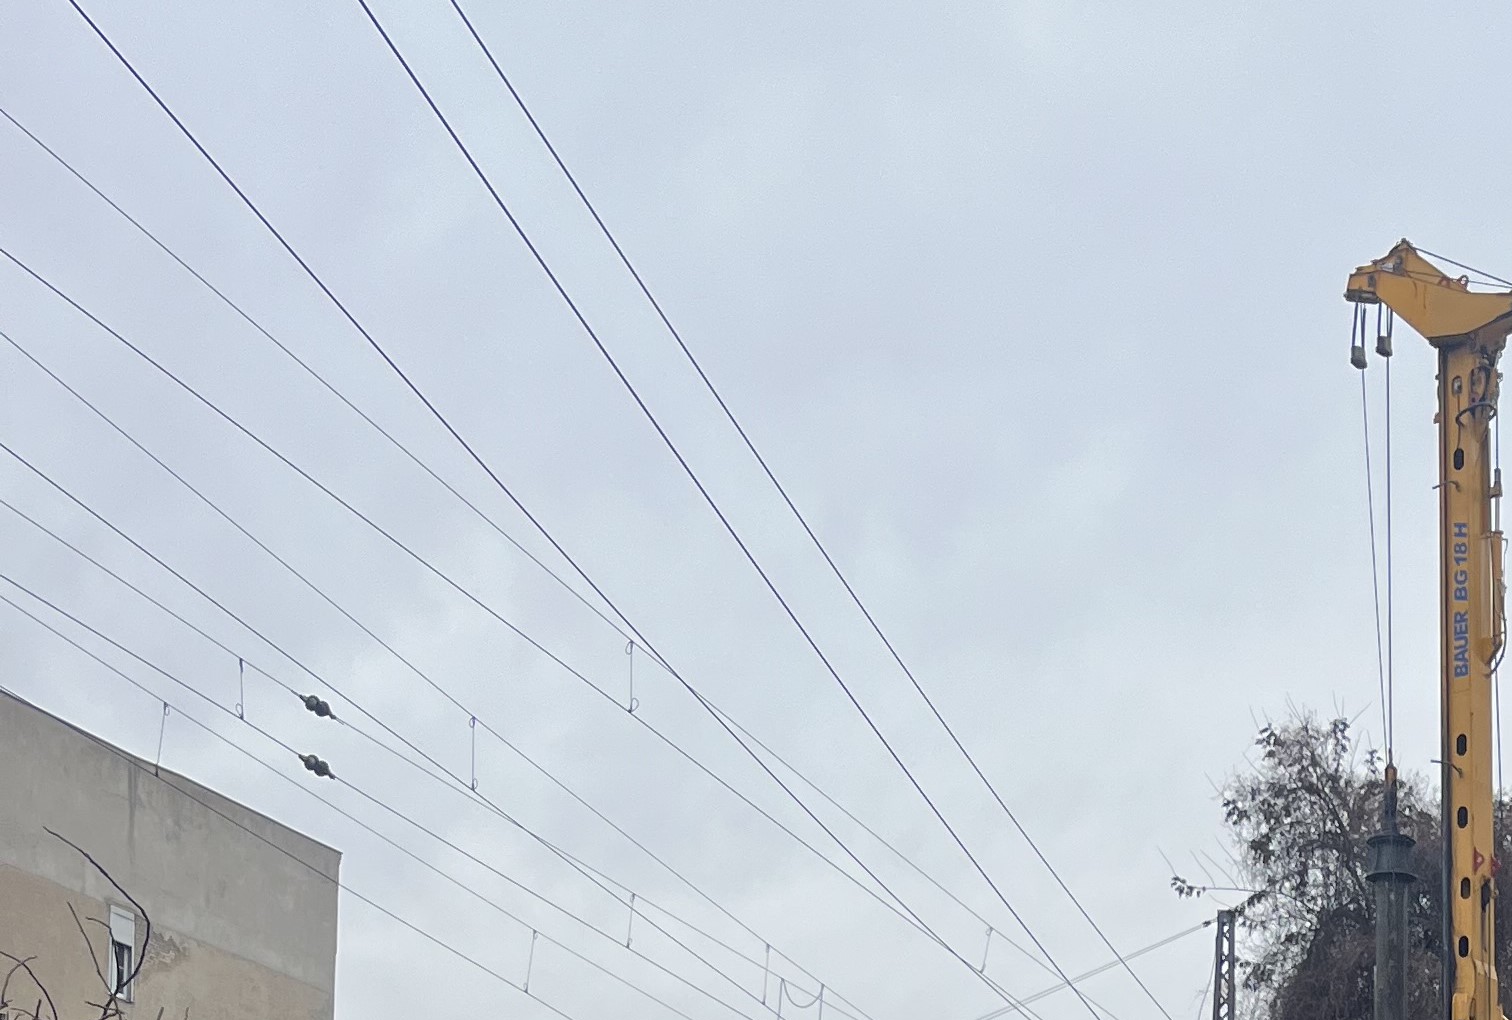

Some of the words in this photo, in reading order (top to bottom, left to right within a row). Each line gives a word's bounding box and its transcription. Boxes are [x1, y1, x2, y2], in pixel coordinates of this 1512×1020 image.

[1454, 522, 1468, 538] H
[1453, 543, 1468, 566] 18
[1454, 569, 1468, 602] BG
[1454, 611, 1469, 678] BAUER
